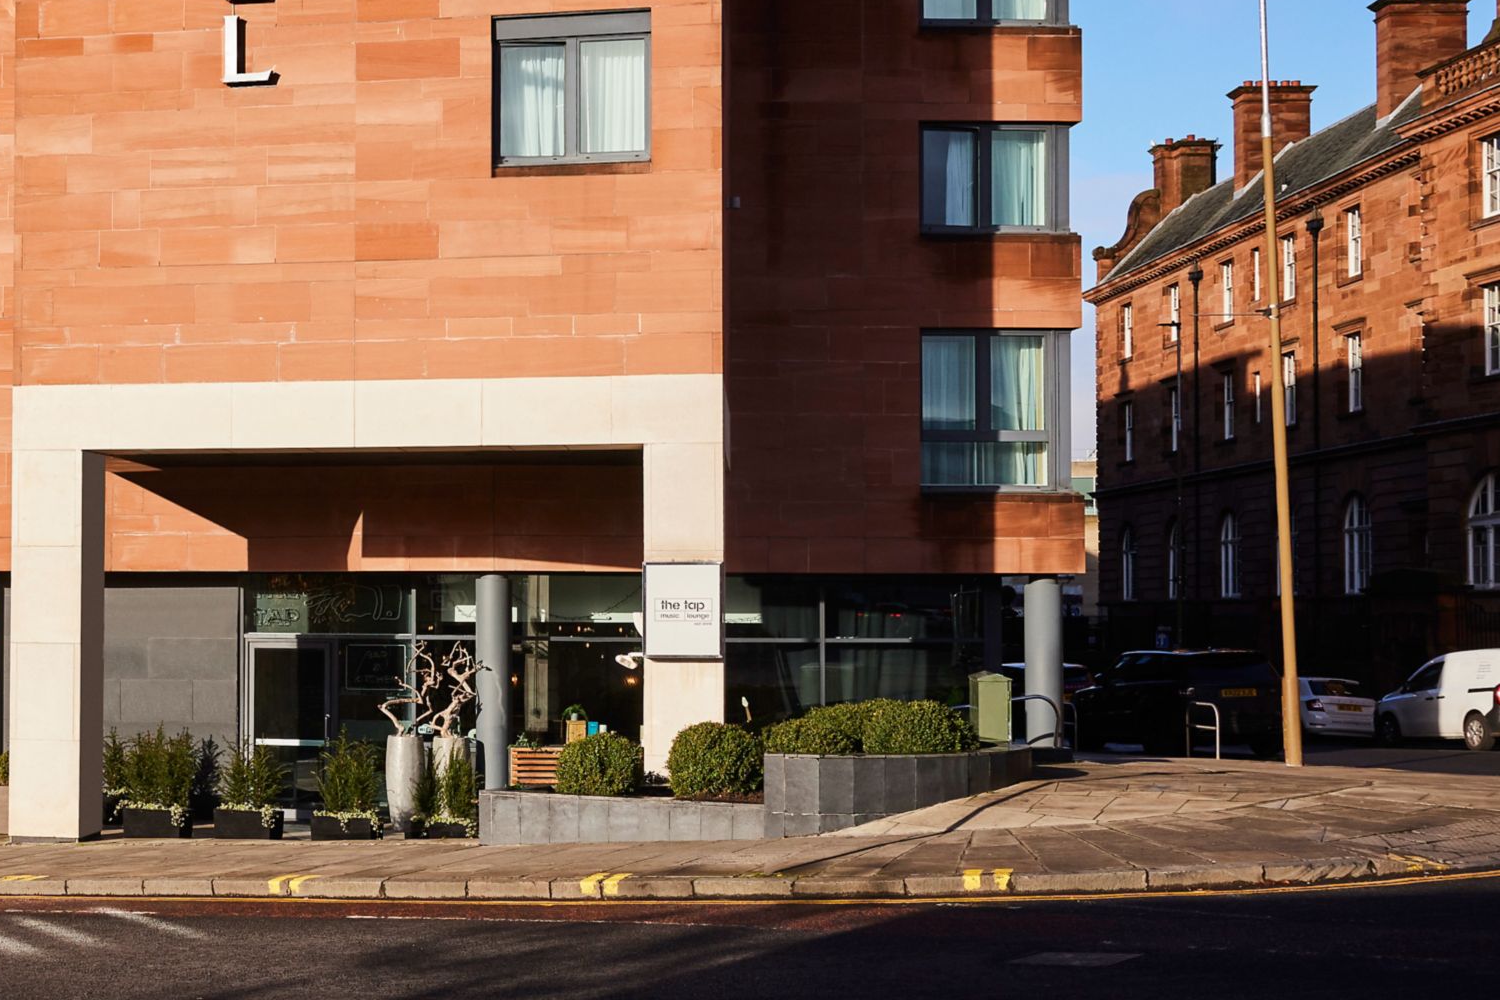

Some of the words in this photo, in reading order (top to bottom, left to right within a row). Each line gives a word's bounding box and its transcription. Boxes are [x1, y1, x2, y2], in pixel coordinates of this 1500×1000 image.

[660, 600, 680, 610] the
[684, 600, 705, 612] tap
[686, 612, 710, 620] lounge
